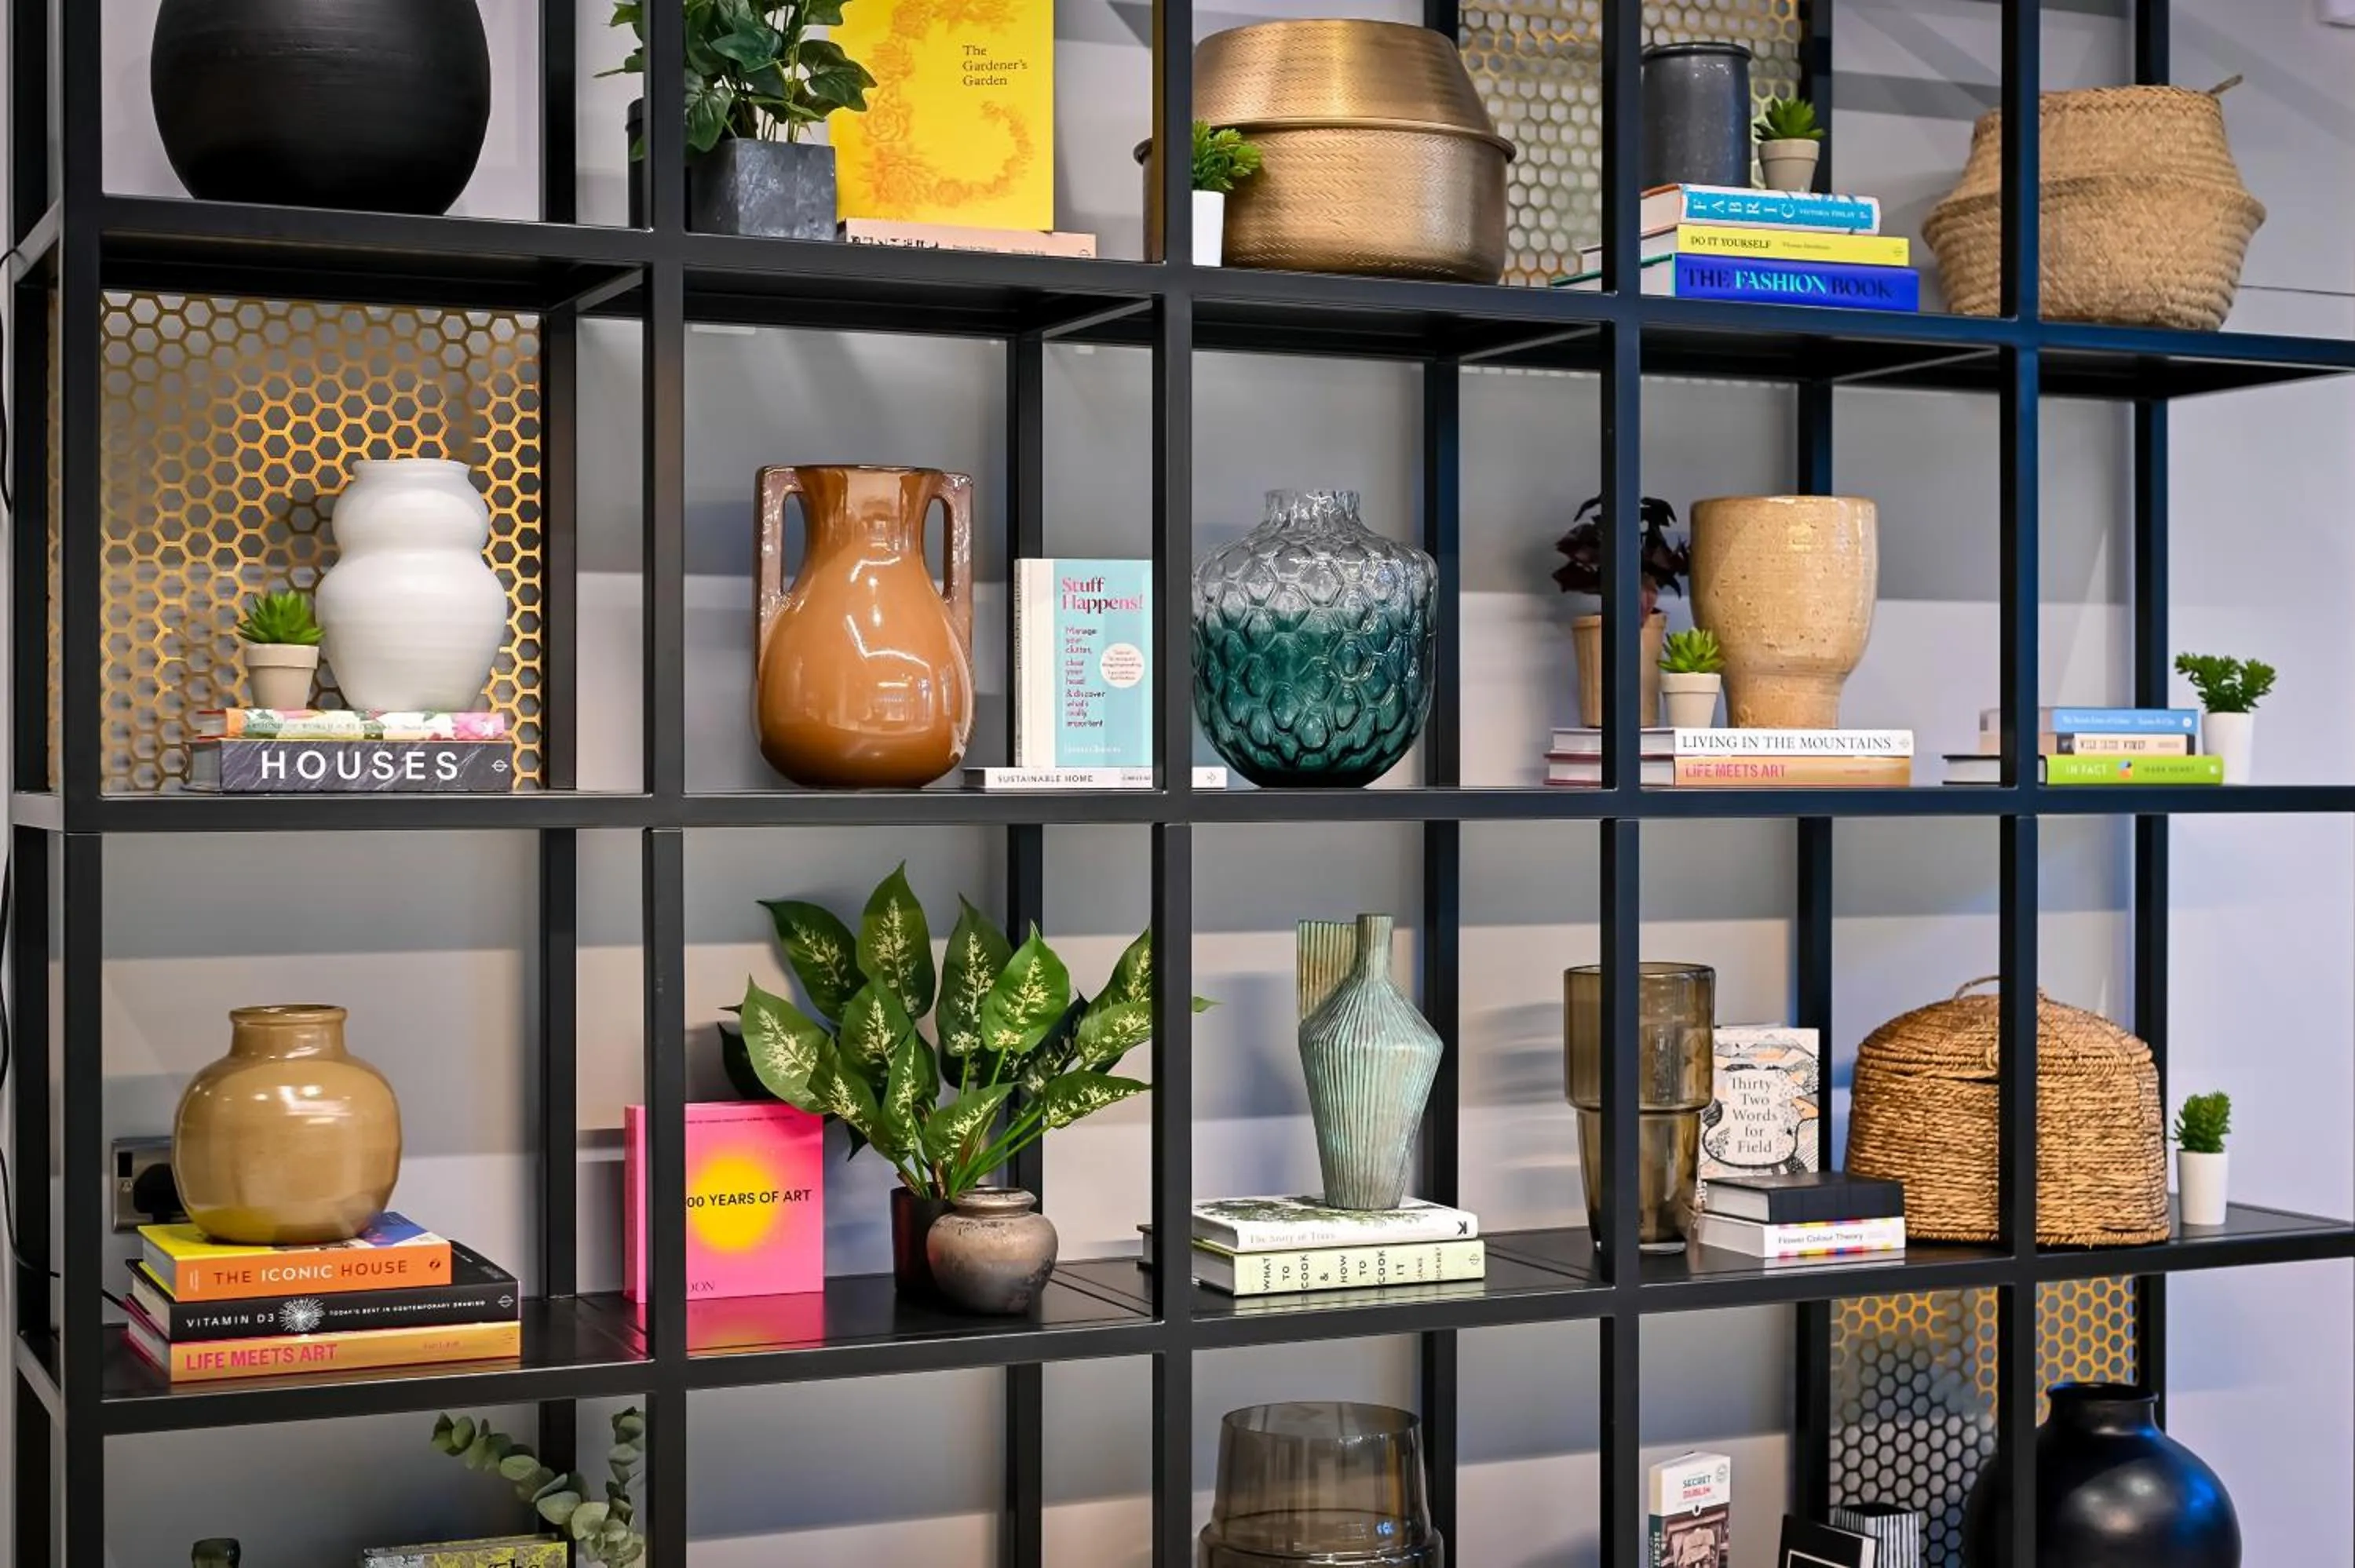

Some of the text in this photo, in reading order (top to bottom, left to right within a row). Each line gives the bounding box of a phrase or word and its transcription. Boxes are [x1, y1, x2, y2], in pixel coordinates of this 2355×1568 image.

[962, 45, 987, 56] The
[962, 59, 1028, 71] Gardener's
[962, 75, 1008, 86] Garden
[1690, 235, 1772, 249] DO IT YOURSELF
[1685, 268, 1894, 299] THE FASHION BOOK
[1061, 577, 1105, 593] Stuff
[1062, 593, 1144, 614] Happens!
[1681, 735, 1892, 749] LIVING IN THE MOUNTAINS
[261, 750, 458, 779] HOUSES
[1685, 764, 1786, 779] LIFE MEETS ART
[998, 775, 1094, 783] SUSTAINABLE HOME
[1731, 1076, 1773, 1092] Thirty
[1740, 1094, 1771, 1106] Two
[1732, 1107, 1778, 1122] Words
[1743, 1126, 1765, 1137] for
[1736, 1140, 1773, 1154] Field
[708, 1192, 755, 1206] YEARS
[759, 1191, 780, 1204] OF
[782, 1189, 812, 1203] ART
[214, 1271, 252, 1285] THE
[261, 1265, 334, 1282] ICONIC
[341, 1260, 407, 1277] HOUSE
[1261, 1250, 1405, 1292] WHAT TO COOK & HOW TO COOK IT
[186, 1313, 275, 1328] VITAMIN D3
[185, 1344, 338, 1370] LIFE MEETS ART
[1682, 1475, 1711, 1488] SECRET
